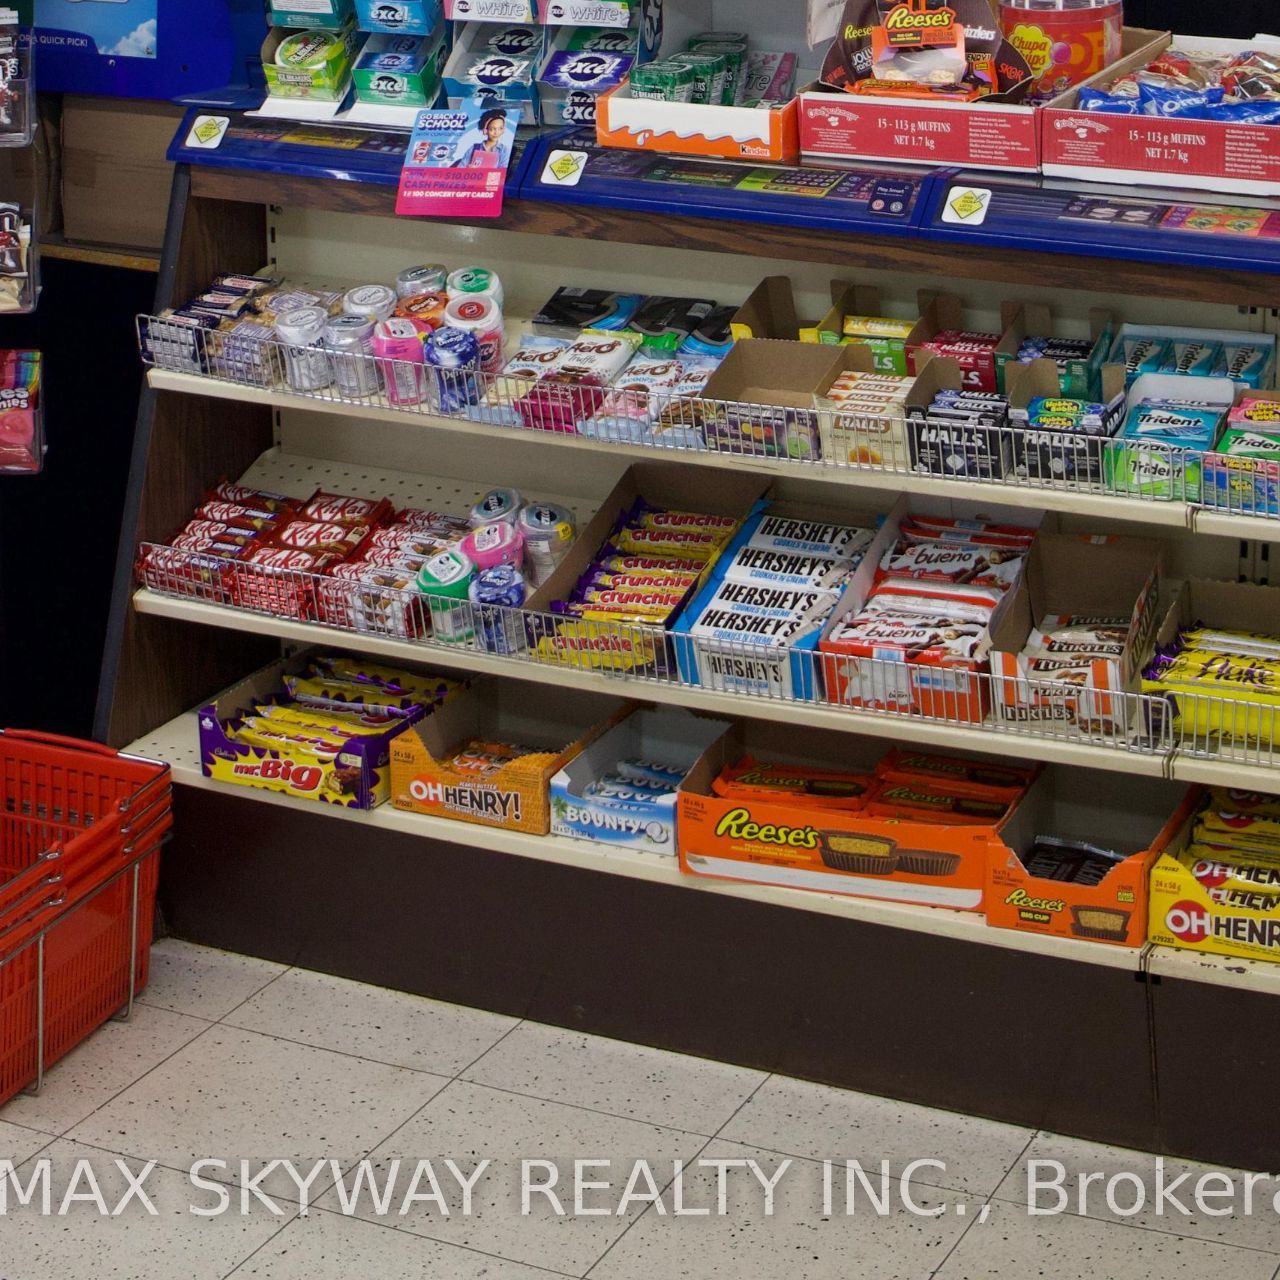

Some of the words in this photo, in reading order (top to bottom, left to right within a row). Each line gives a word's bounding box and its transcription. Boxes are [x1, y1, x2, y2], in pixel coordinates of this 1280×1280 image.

[886, 6, 952, 30] Reese's
[418, 120, 465, 129] SCHOOL
[878, 119, 886, 129] 15
[894, 119, 908, 130] 113
[910, 123, 916, 132] g
[917, 120, 951, 134] MUFFINS
[894, 134, 910, 145] NET
[912, 135, 923, 146] 1.7
[924, 136, 935, 149] kg
[1137, 411, 1203, 430] Trident
[631, 528, 714, 546] crunchie
[410, 780, 444, 805] OH
[444, 783, 520, 820] HENRY!
[566, 806, 640, 835] BOUNTY
